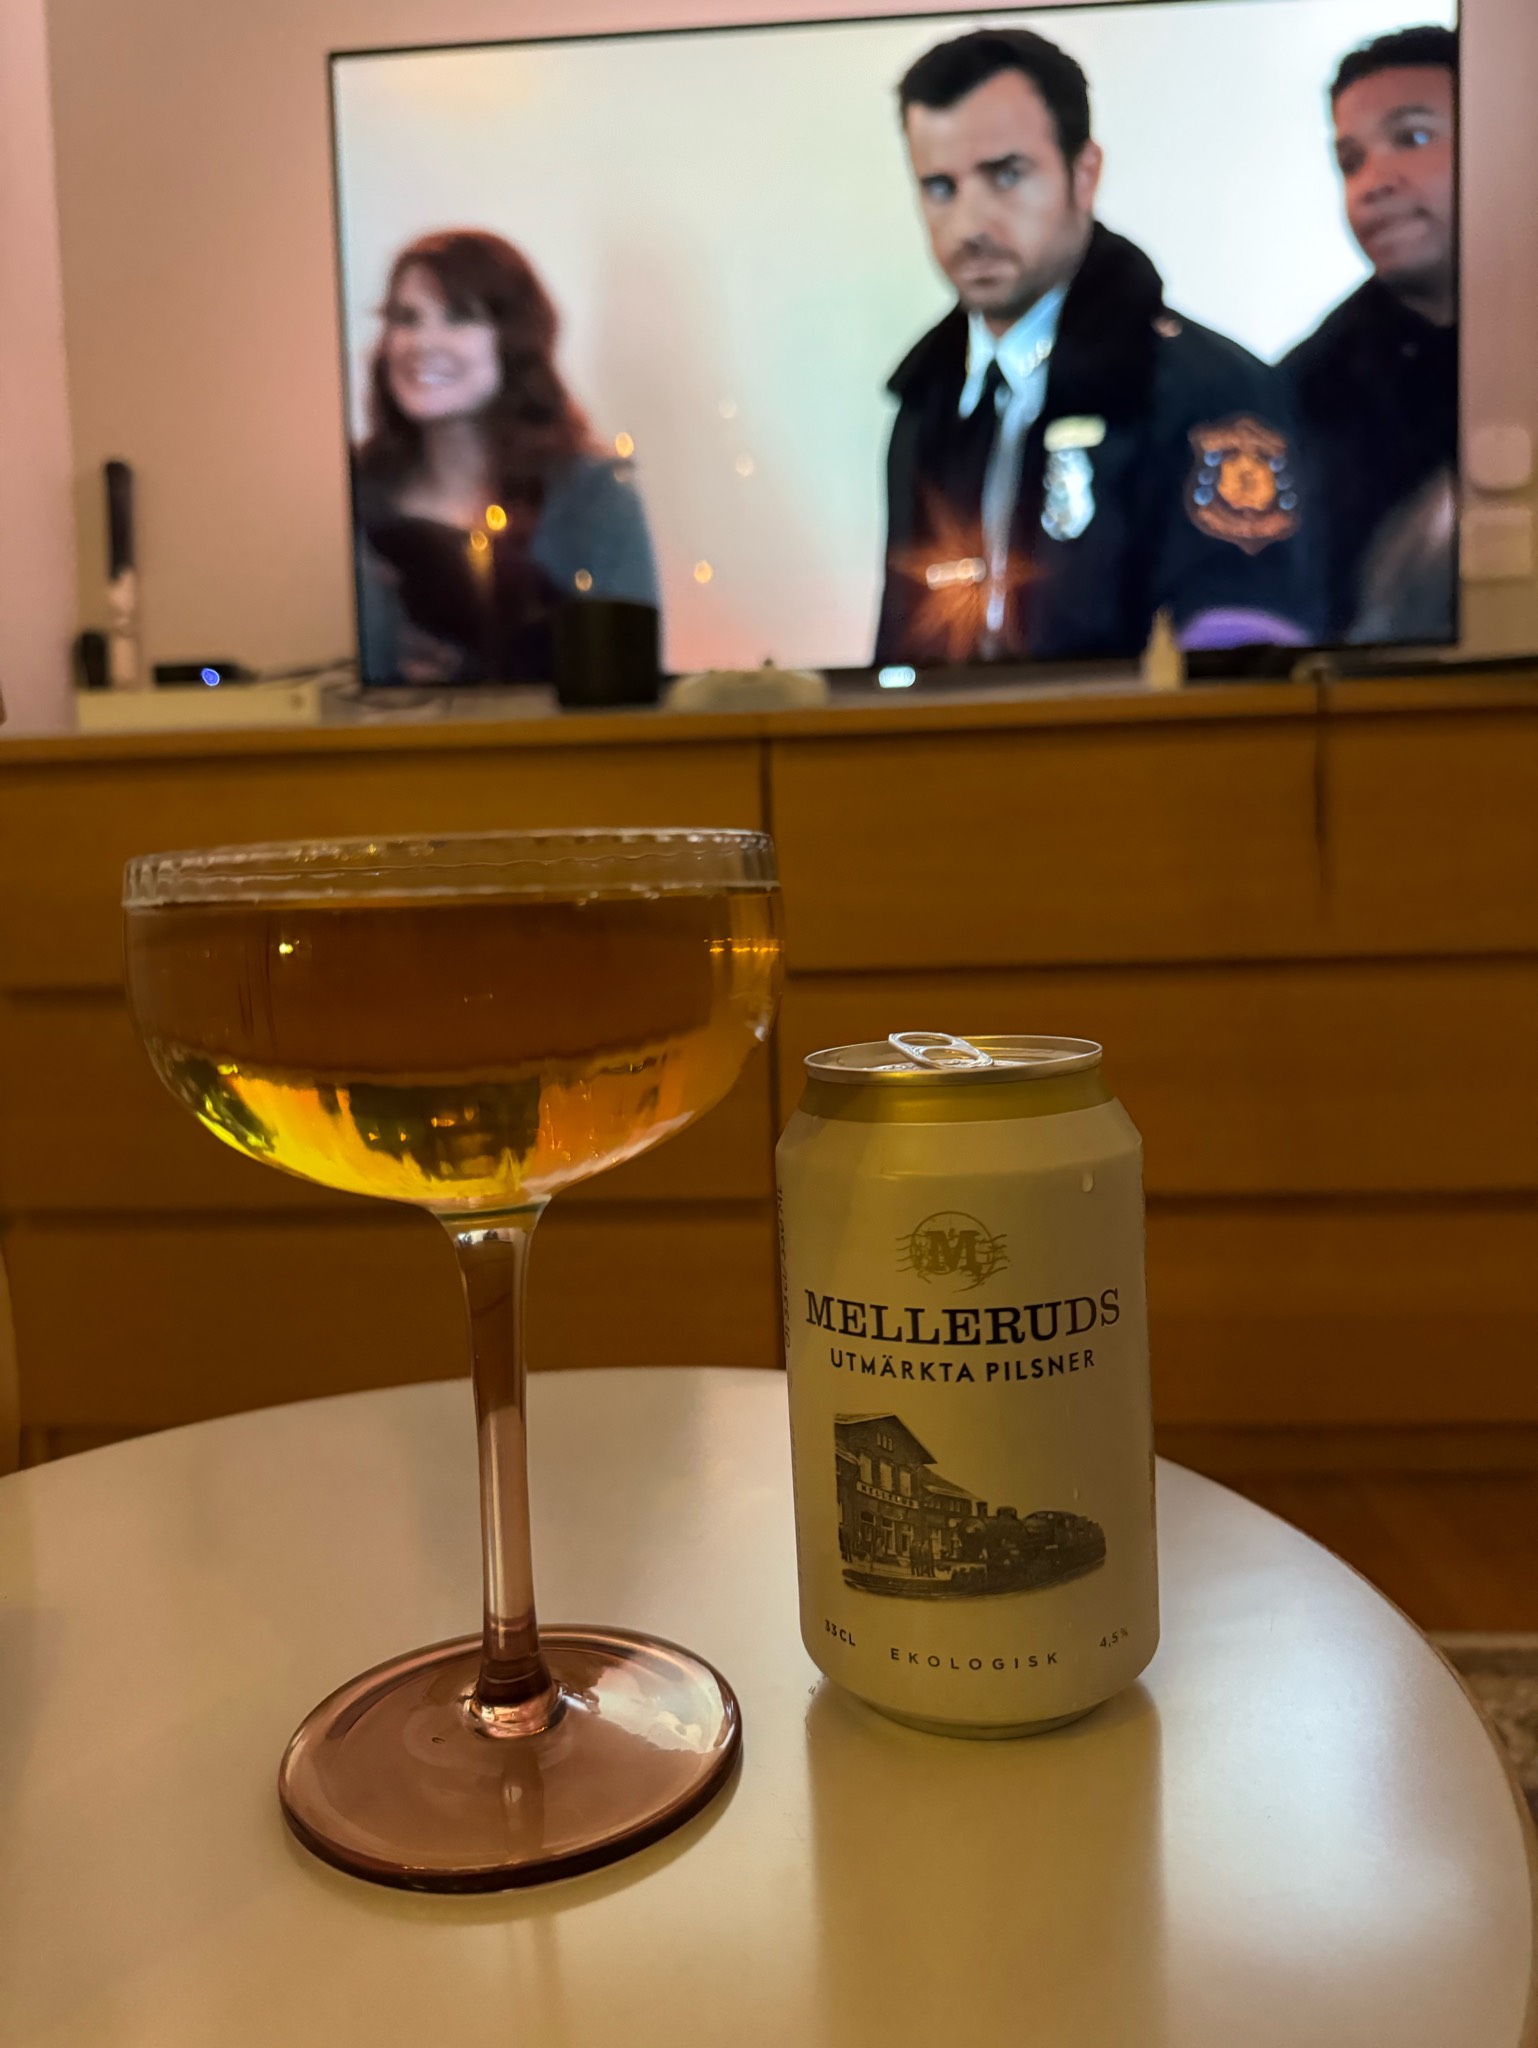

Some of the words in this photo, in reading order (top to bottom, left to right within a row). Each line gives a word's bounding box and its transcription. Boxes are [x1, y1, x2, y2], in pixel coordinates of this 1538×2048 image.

[804, 1288, 1120, 1346] MELLERUDS
[830, 1347, 975, 1383] UTMÄRKTA
[986, 1349, 1095, 1382] PILSNER
[824, 1619, 856, 1647] 33CL
[890, 1648, 1057, 1671] EKOLOGISK
